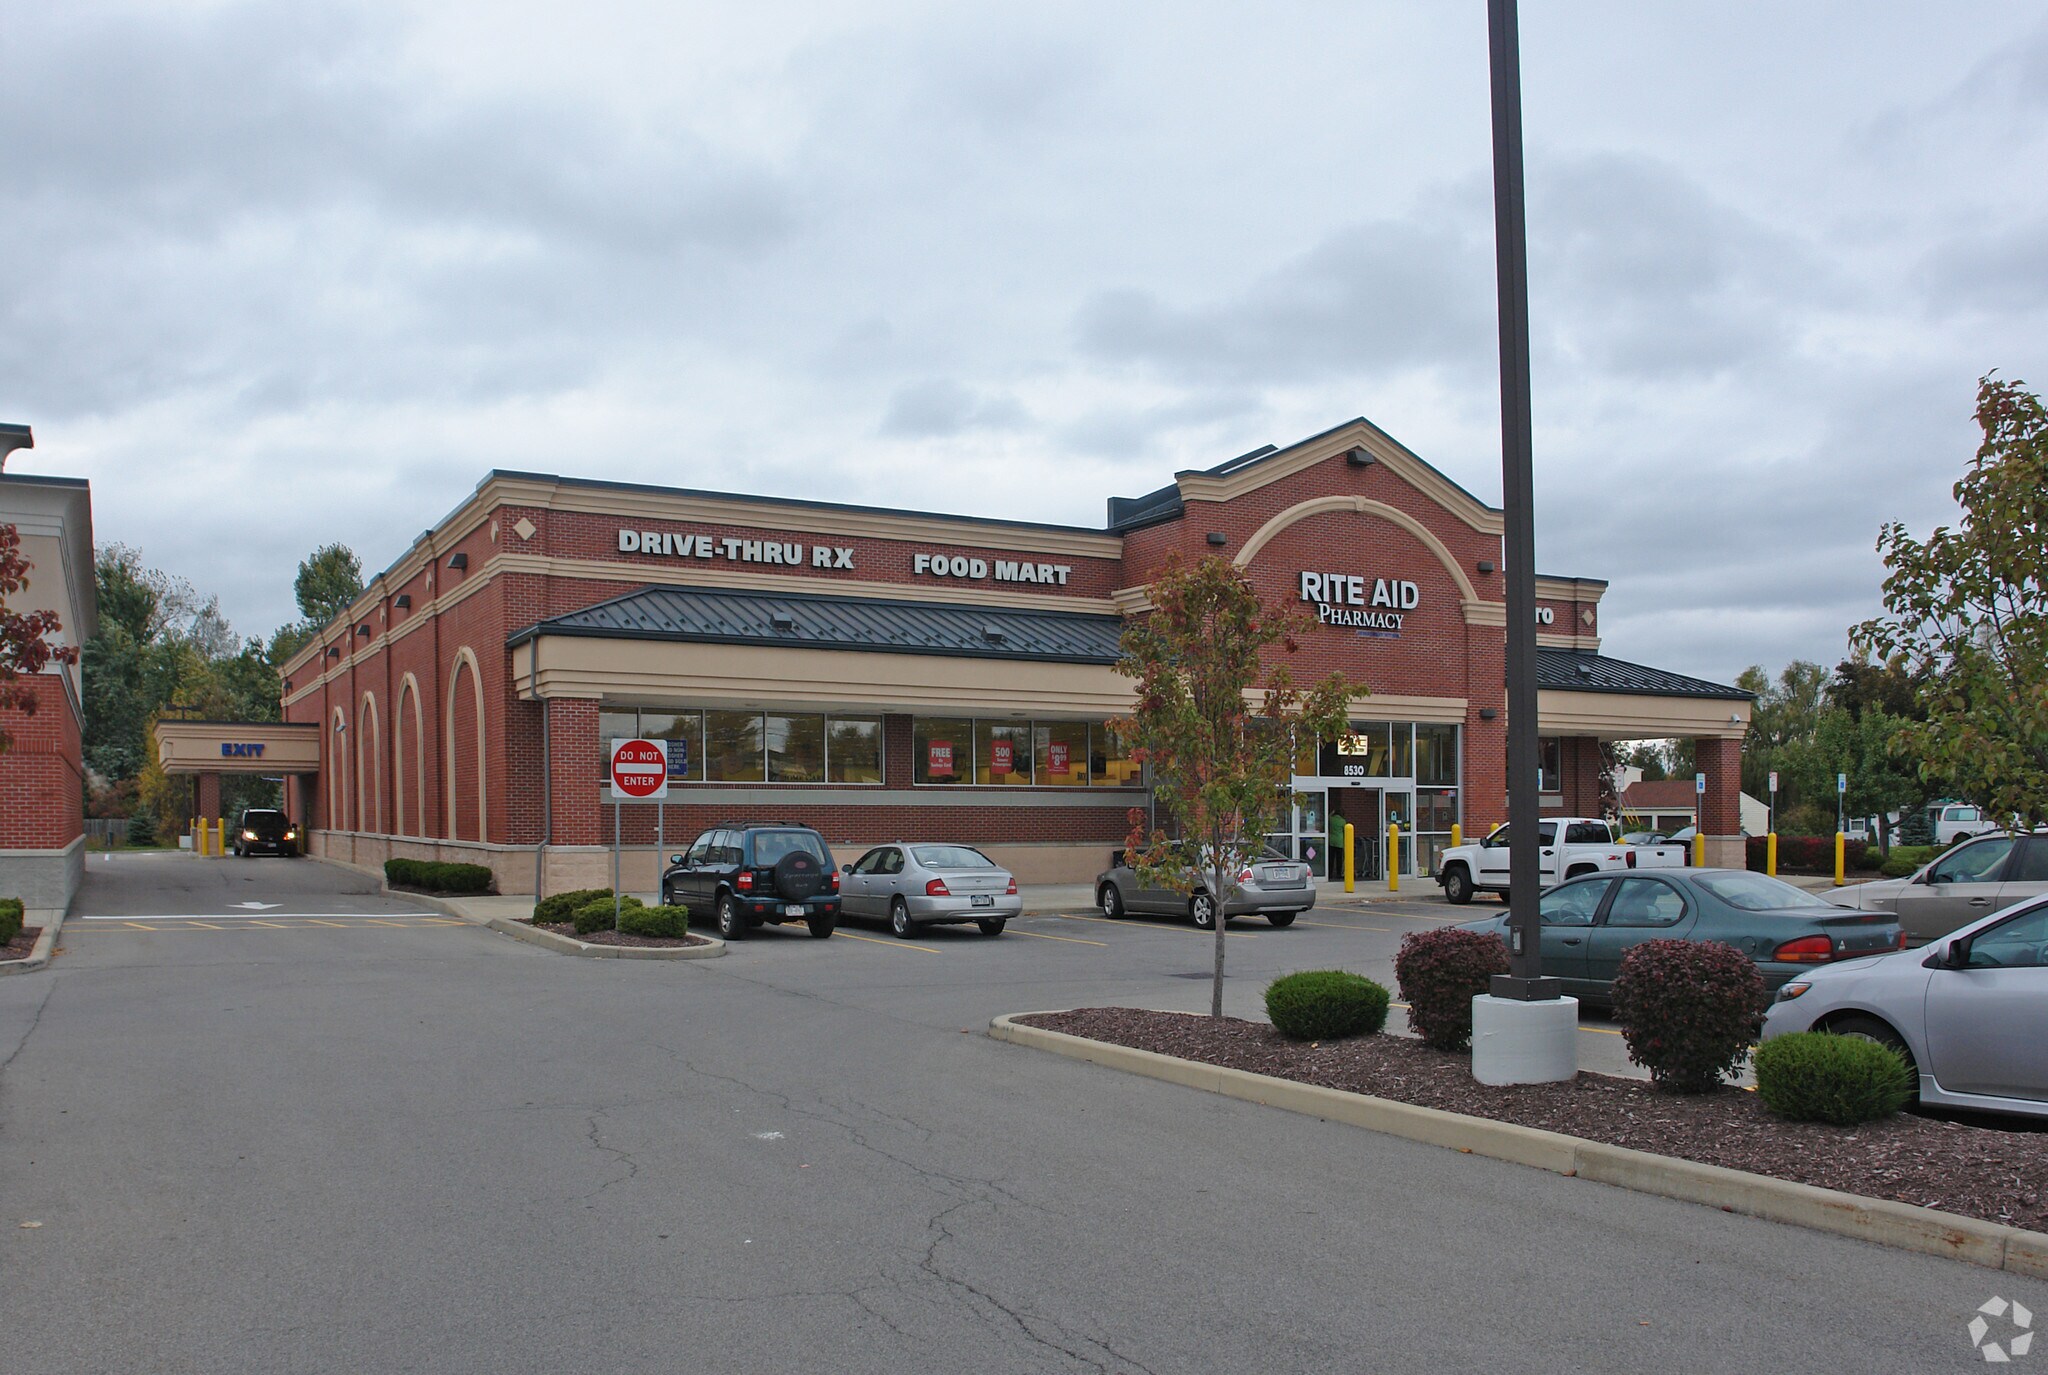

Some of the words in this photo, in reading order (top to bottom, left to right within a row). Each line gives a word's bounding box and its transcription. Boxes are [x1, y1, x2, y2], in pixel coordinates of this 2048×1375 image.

[618, 529, 802, 565] DRIVE-THRU
[812, 546, 855, 569] RX
[914, 553, 988, 579] FOOD
[995, 560, 1072, 585] MART
[1301, 571, 1365, 605] RITE
[1371, 578, 1419, 610] AID
[1318, 603, 1404, 629] PHARMACY
[221, 743, 265, 757] EXIT
[931, 747, 951, 758] FREE
[995, 747, 1010, 757] 500
[1050, 745, 1068, 754] ONLY
[620, 751, 634, 760] DO
[639, 751, 659, 760] NOT
[1344, 765, 1364, 776] 8530
[623, 776, 655, 786] ENTER
